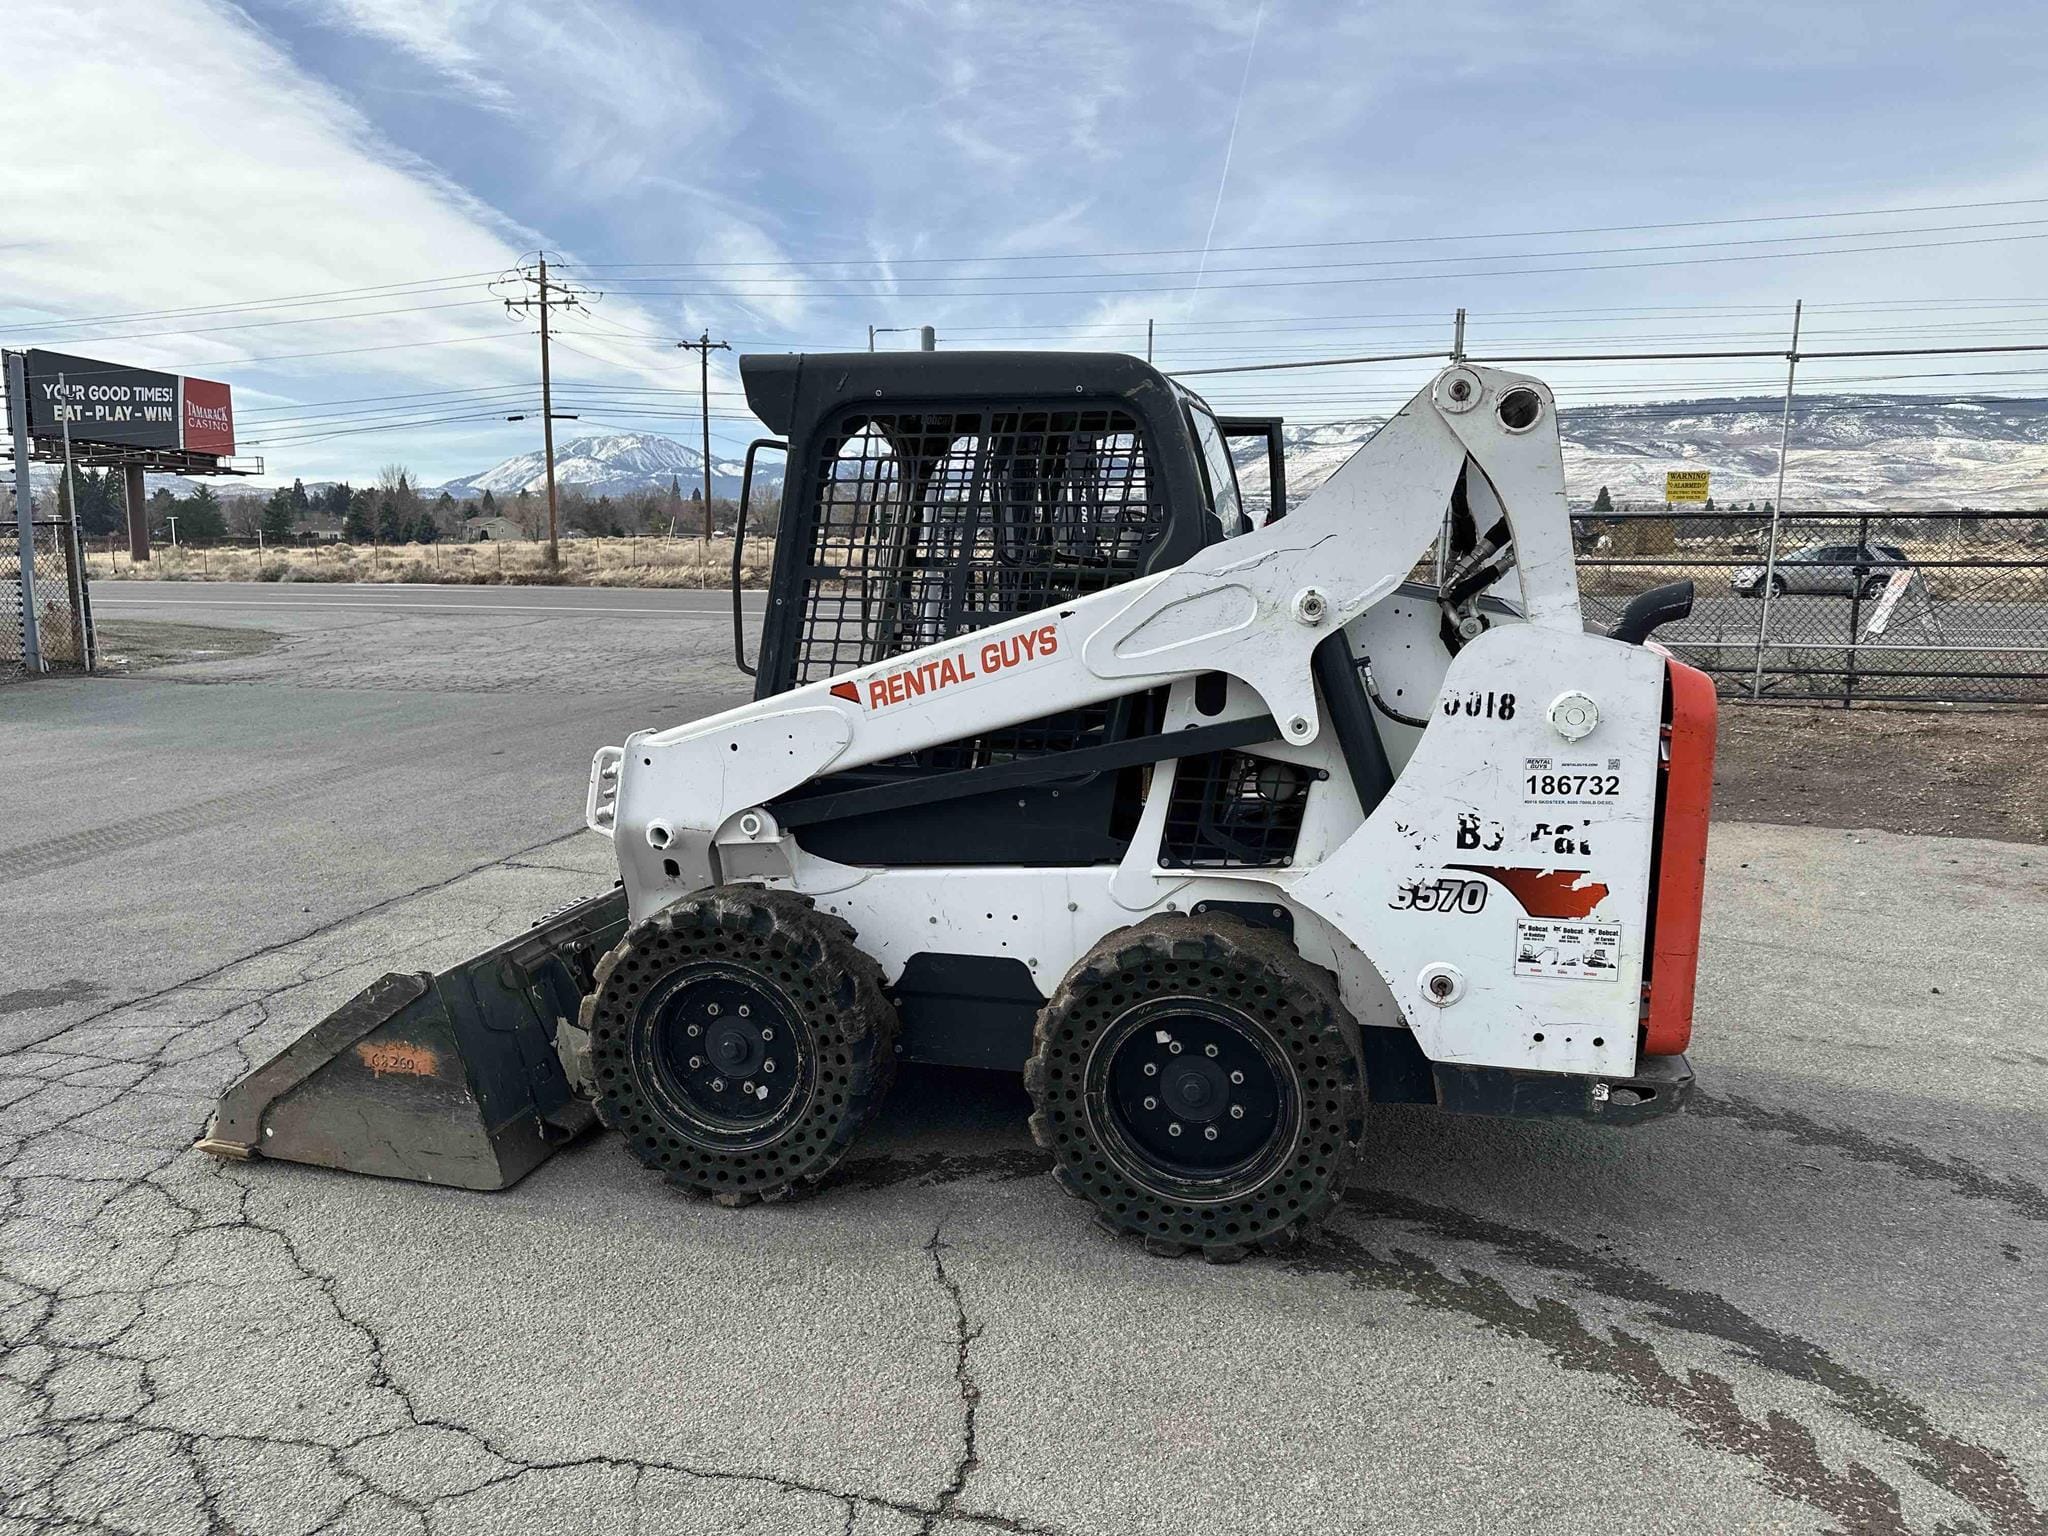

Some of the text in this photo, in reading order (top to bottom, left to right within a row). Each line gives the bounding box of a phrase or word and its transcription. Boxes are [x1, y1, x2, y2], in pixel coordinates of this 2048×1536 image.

[42, 383, 173, 402] YOUR GOOD TIMES!
[53, 404, 83, 421] EAT
[95, 405, 133, 421] PLAY
[143, 406, 173, 422] WIN
[186, 399, 228, 421] TAMARACK
[188, 417, 229, 432] CASINO
[1671, 472, 1707, 480] WARNING
[869, 625, 1058, 710] RENTAL GUYS
[1526, 775, 1620, 796] 186732
